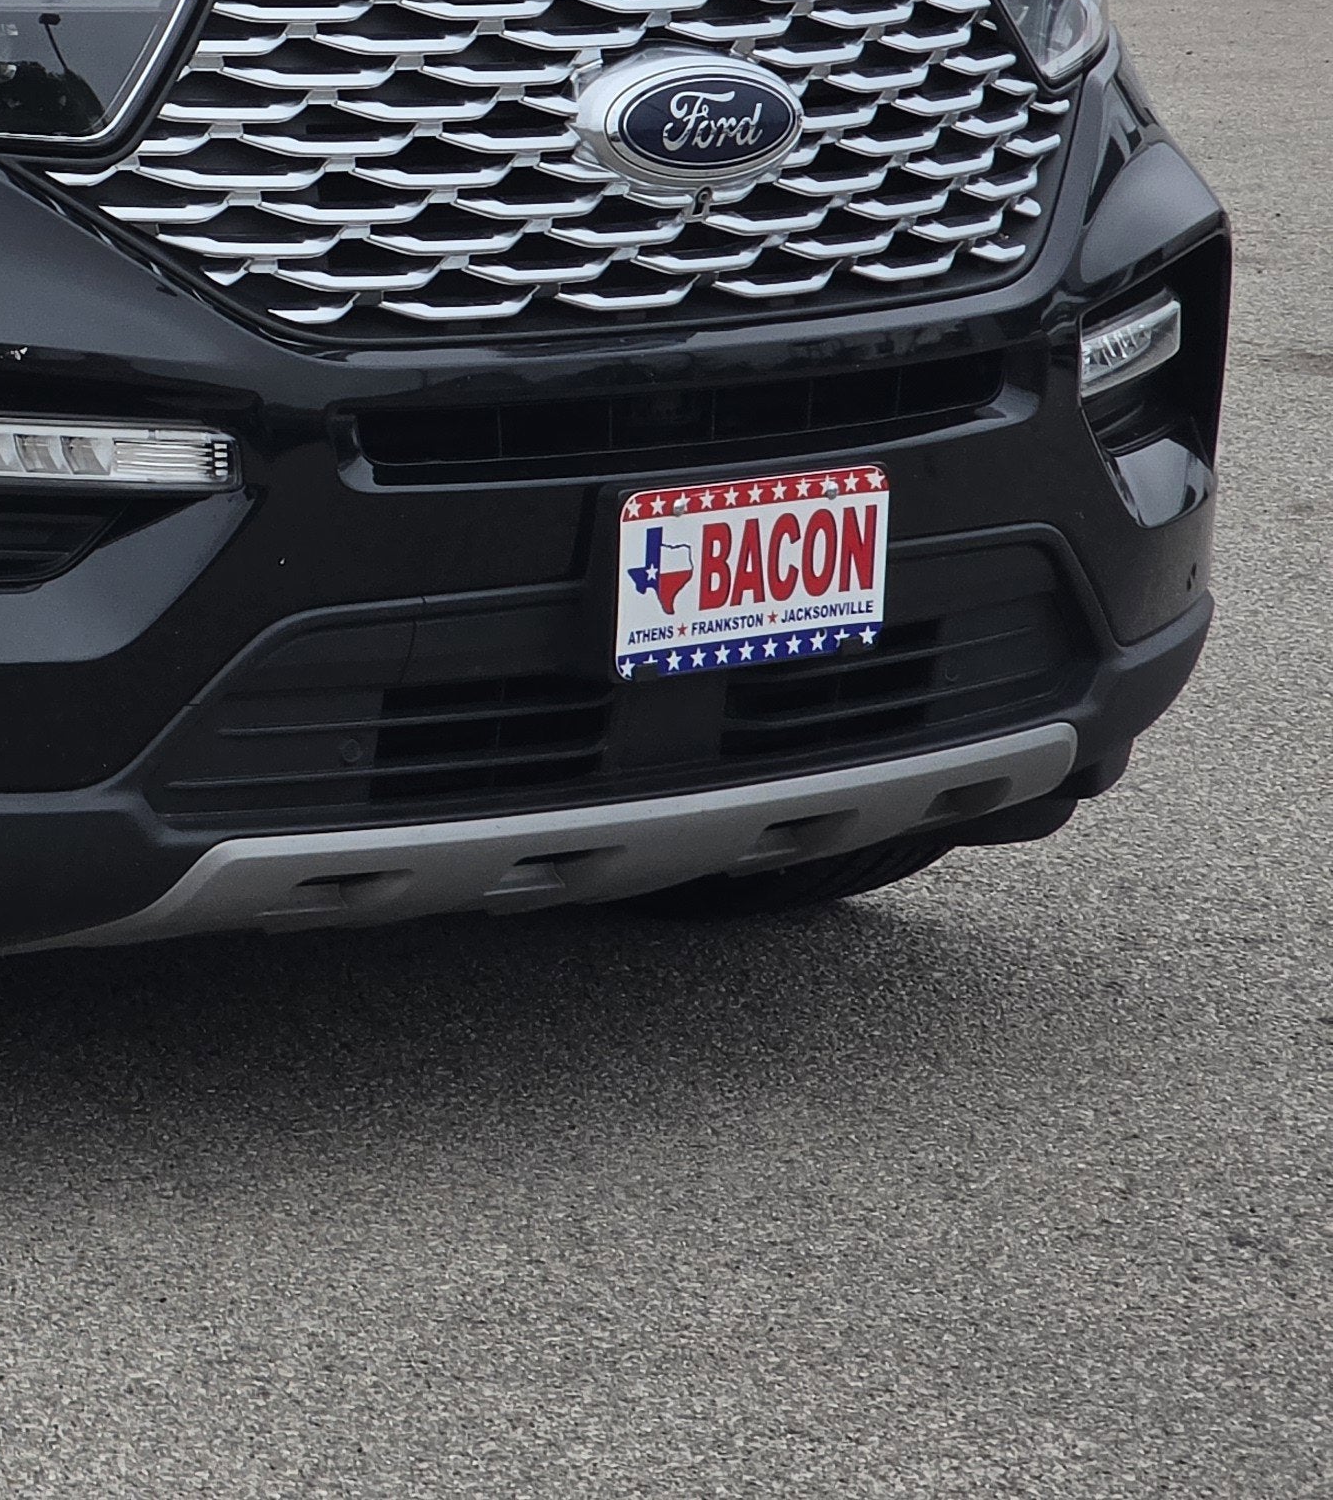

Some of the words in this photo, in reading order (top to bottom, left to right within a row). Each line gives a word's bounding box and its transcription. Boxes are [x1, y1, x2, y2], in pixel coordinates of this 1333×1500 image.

[663, 90, 763, 151] Ford
[698, 504, 878, 611] BACON
[627, 625, 674, 645] ATHENS
[691, 613, 764, 636] FRANKSTON
[781, 600, 874, 623] JACKSONVILLE
